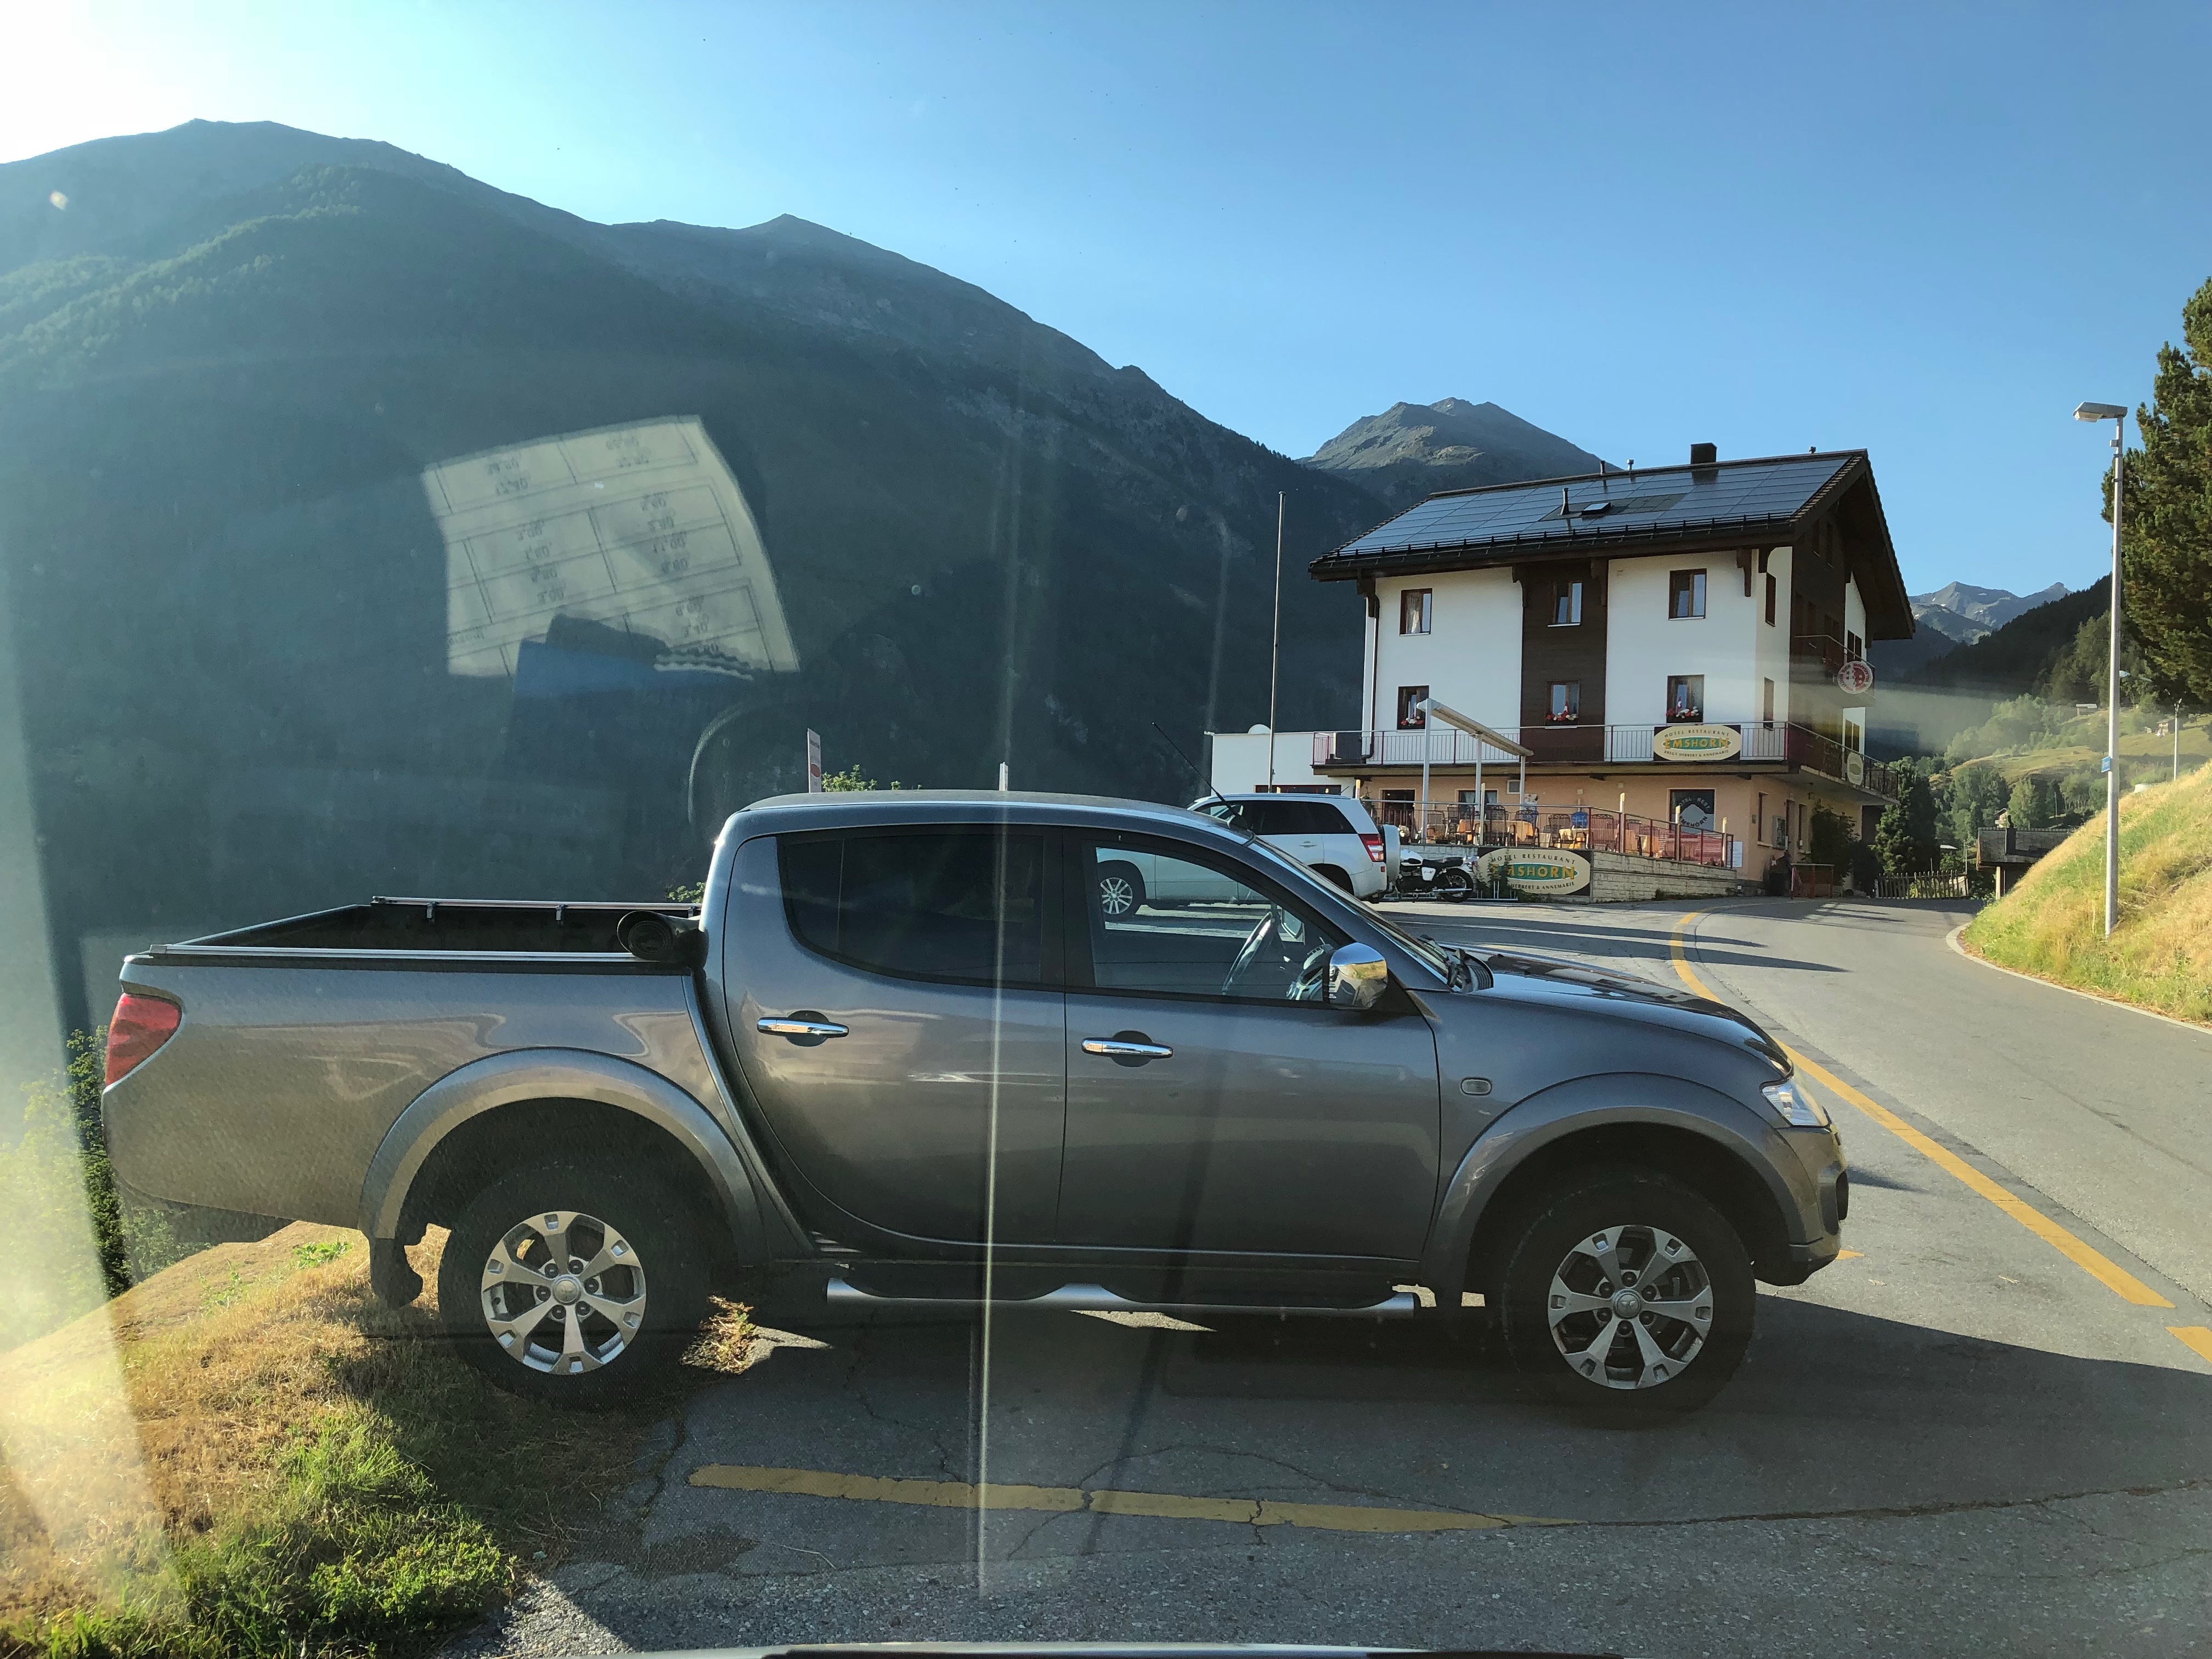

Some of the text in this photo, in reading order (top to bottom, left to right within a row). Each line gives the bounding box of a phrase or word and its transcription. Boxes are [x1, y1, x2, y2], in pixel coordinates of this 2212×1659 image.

[1665, 737, 1729, 749] EMSHORN
[1522, 854, 1575, 865] RESTAURANT
[1542, 881, 1575, 890] ANNEMARIE
